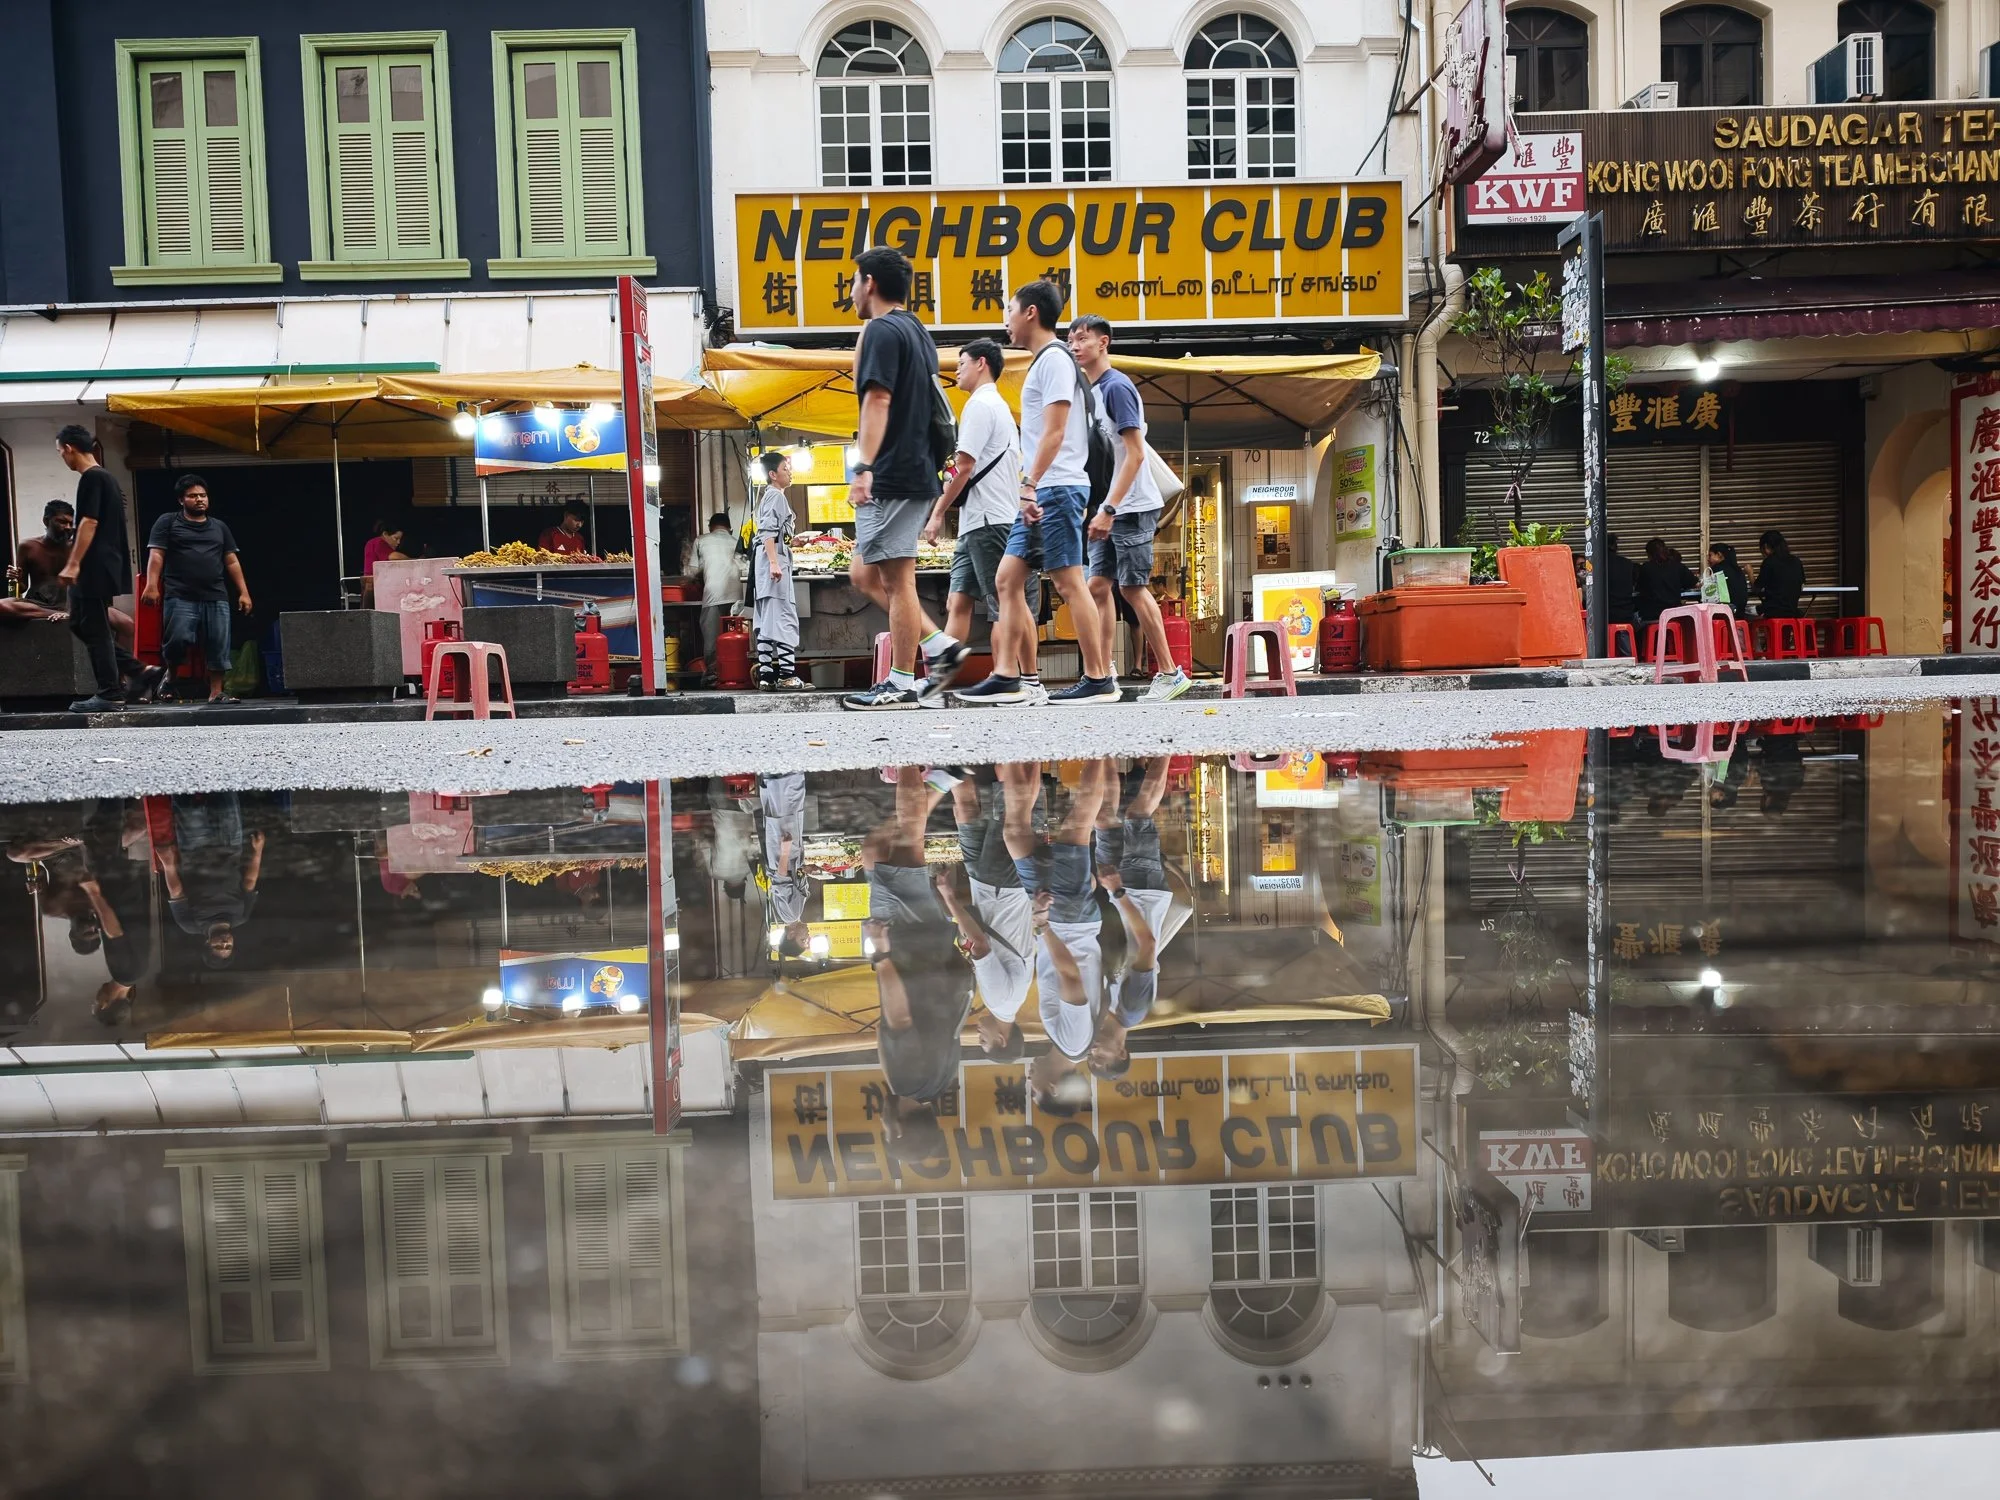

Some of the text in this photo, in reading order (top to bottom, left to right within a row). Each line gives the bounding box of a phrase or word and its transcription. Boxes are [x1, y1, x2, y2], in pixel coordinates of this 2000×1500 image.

[1714, 112, 1923, 149] SAUDAGAR
[1587, 149, 2000, 193] KONG WOOI FONG TEA MERCHAN
[1475, 177, 1577, 209] KWF
[754, 197, 1387, 262] NEIGHBOUR CLUB
[1474, 431, 1489, 444] 72
[1244, 449, 1261, 463] 70
